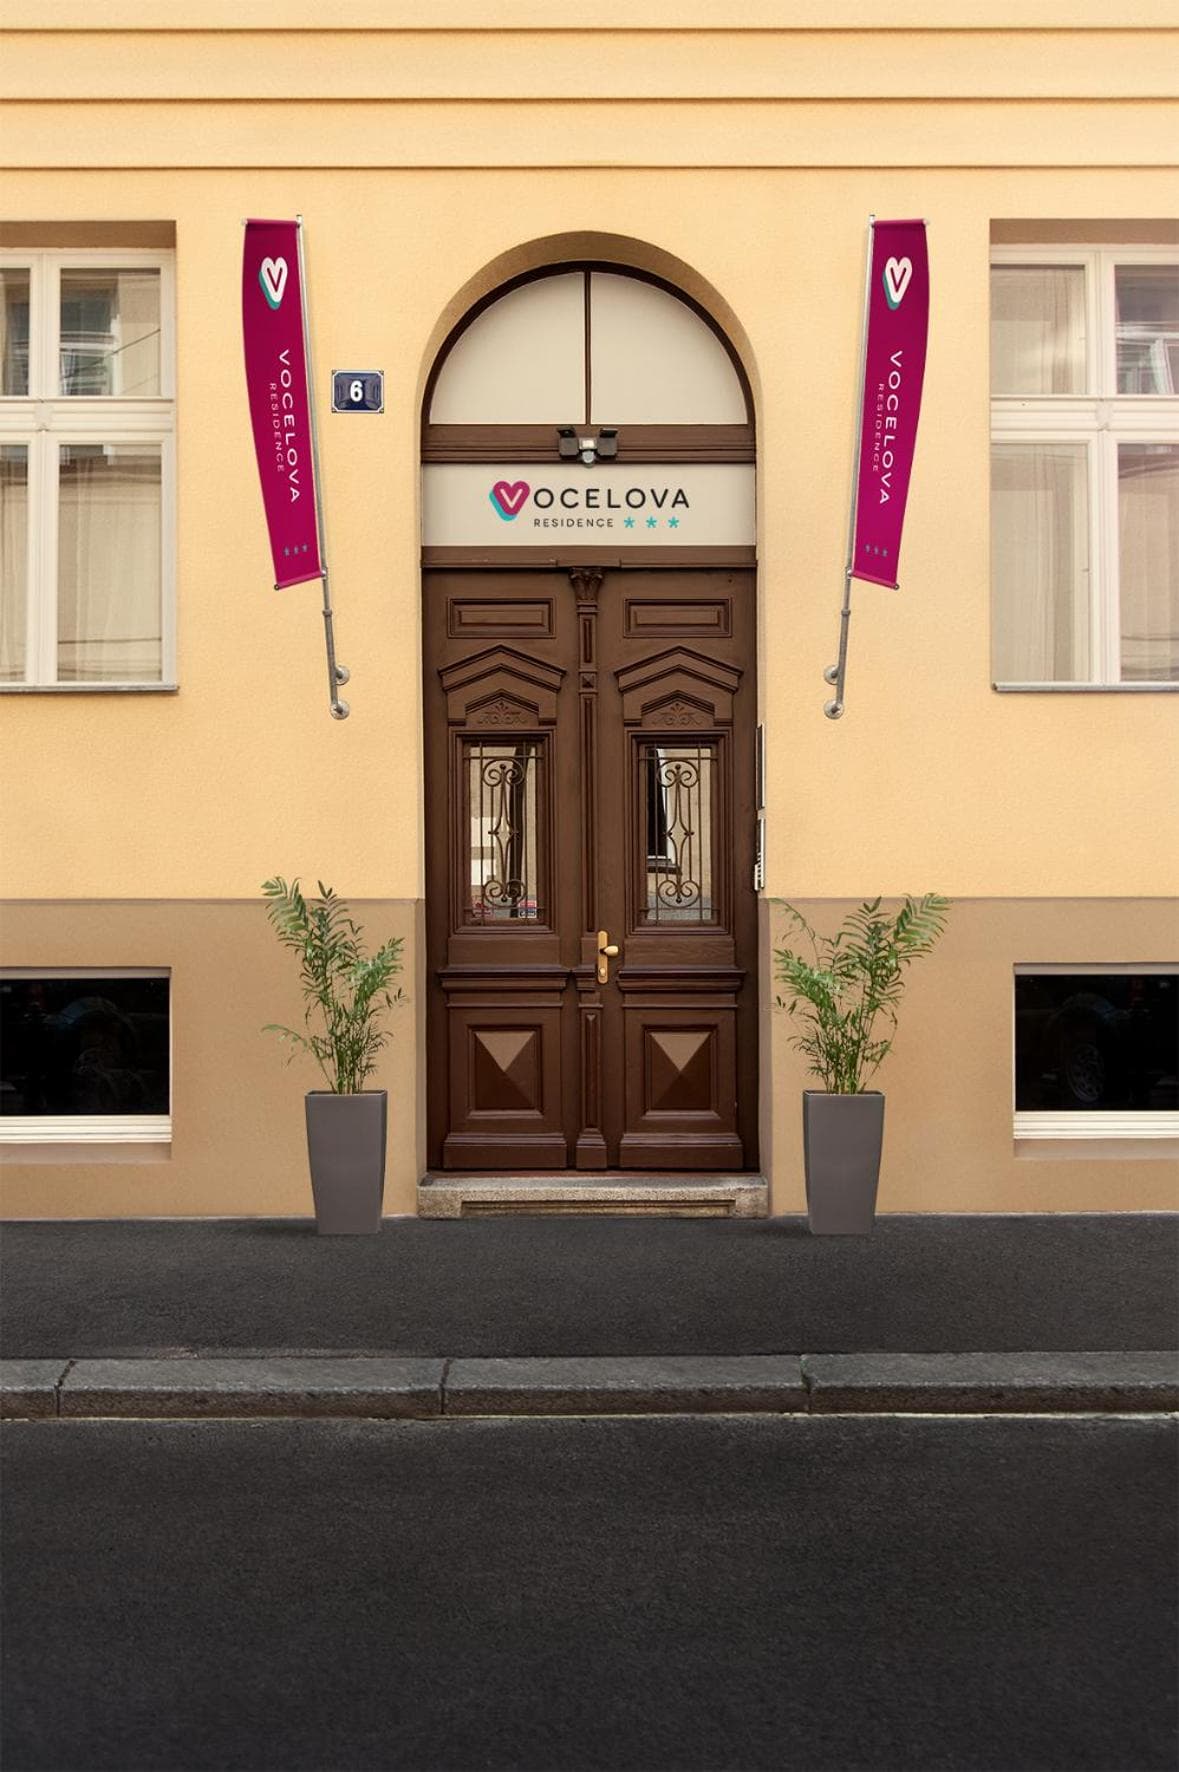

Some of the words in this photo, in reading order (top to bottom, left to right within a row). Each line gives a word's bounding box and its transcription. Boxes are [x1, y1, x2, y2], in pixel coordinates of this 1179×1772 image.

[269, 382, 285, 473] RESIDENCE
[278, 349, 301, 503] VOCELOVA
[350, 380, 363, 402] 6
[872, 382, 885, 473] RESIDENCE
[879, 350, 903, 504] VOCELOVA
[533, 518, 614, 528] RESIDENCE
